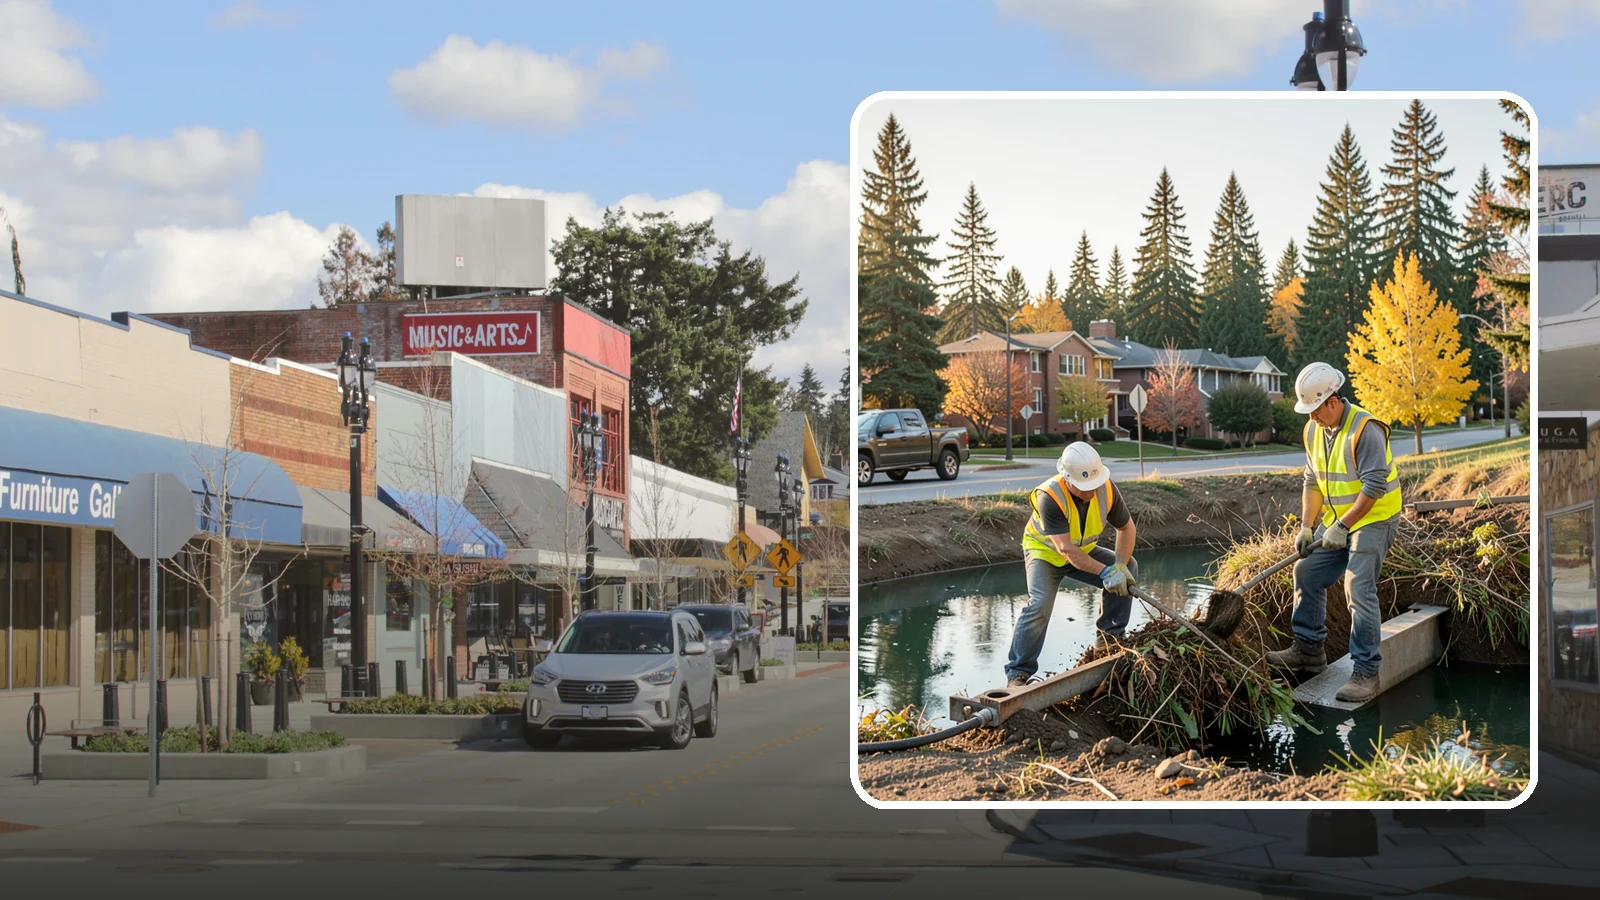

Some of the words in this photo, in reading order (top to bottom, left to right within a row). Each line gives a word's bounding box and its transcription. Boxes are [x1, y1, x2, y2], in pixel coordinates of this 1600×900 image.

[409, 323, 519, 348] MUSIC&ARTS
[0, 471, 79, 515] Furniture
[453, 563, 479, 574] SUSHI
